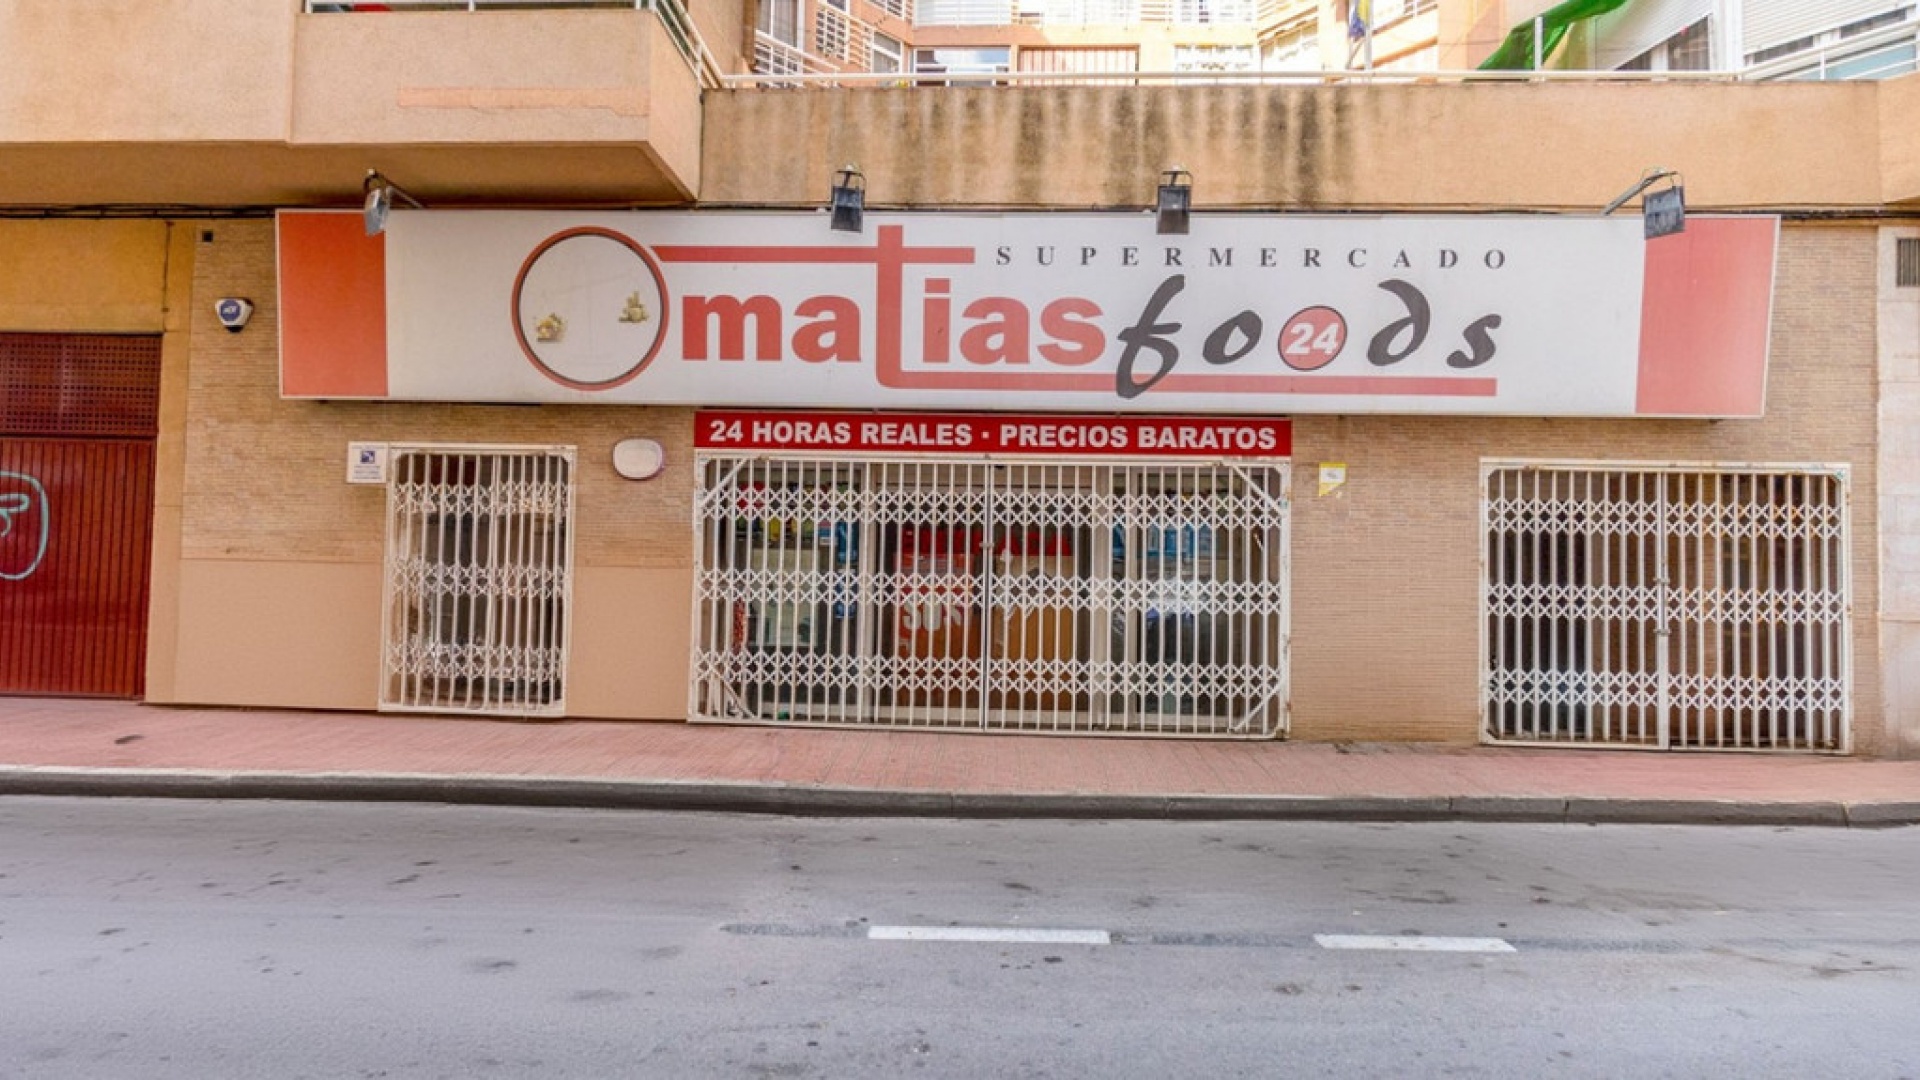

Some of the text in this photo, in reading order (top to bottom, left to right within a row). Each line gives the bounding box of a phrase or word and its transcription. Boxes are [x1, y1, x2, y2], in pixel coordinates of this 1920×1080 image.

[996, 247, 1506, 269] SUPERMERCADO
[681, 225, 1107, 388] matias
[709, 420, 1277, 450] 24 HORAS REALES PRECIOS BARATOS
